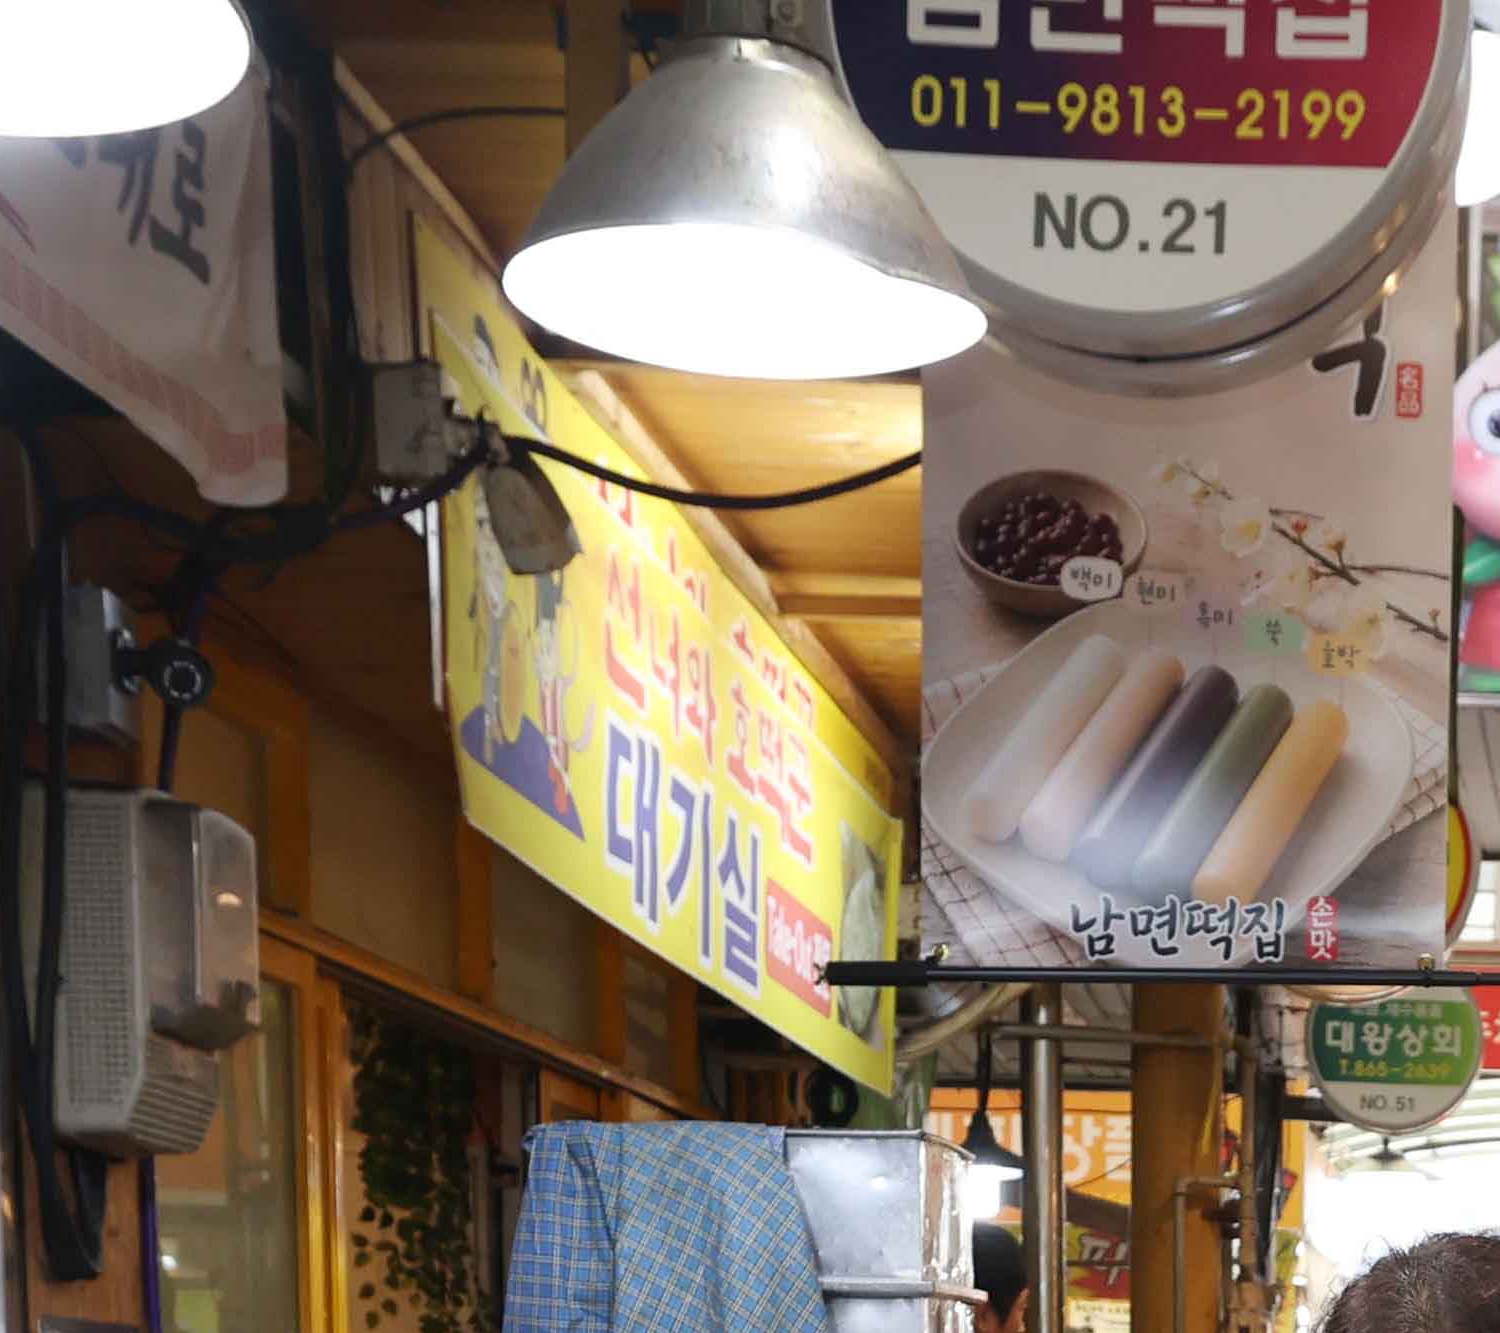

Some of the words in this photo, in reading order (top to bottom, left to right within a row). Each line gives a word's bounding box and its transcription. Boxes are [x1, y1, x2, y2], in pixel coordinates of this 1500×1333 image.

[911, 74, 1367, 142] 011-9813-2199
[1032, 192, 1229, 256] NO.21
[1069, 563, 1114, 592] 백미
[1137, 576, 1177, 606] 현미
[604, 720, 762, 993] 대기실
[1068, 893, 1287, 962] 남면떡집
[1308, 896, 1338, 961] 손맛
[1325, 1019, 1461, 1058] 대왕상회
